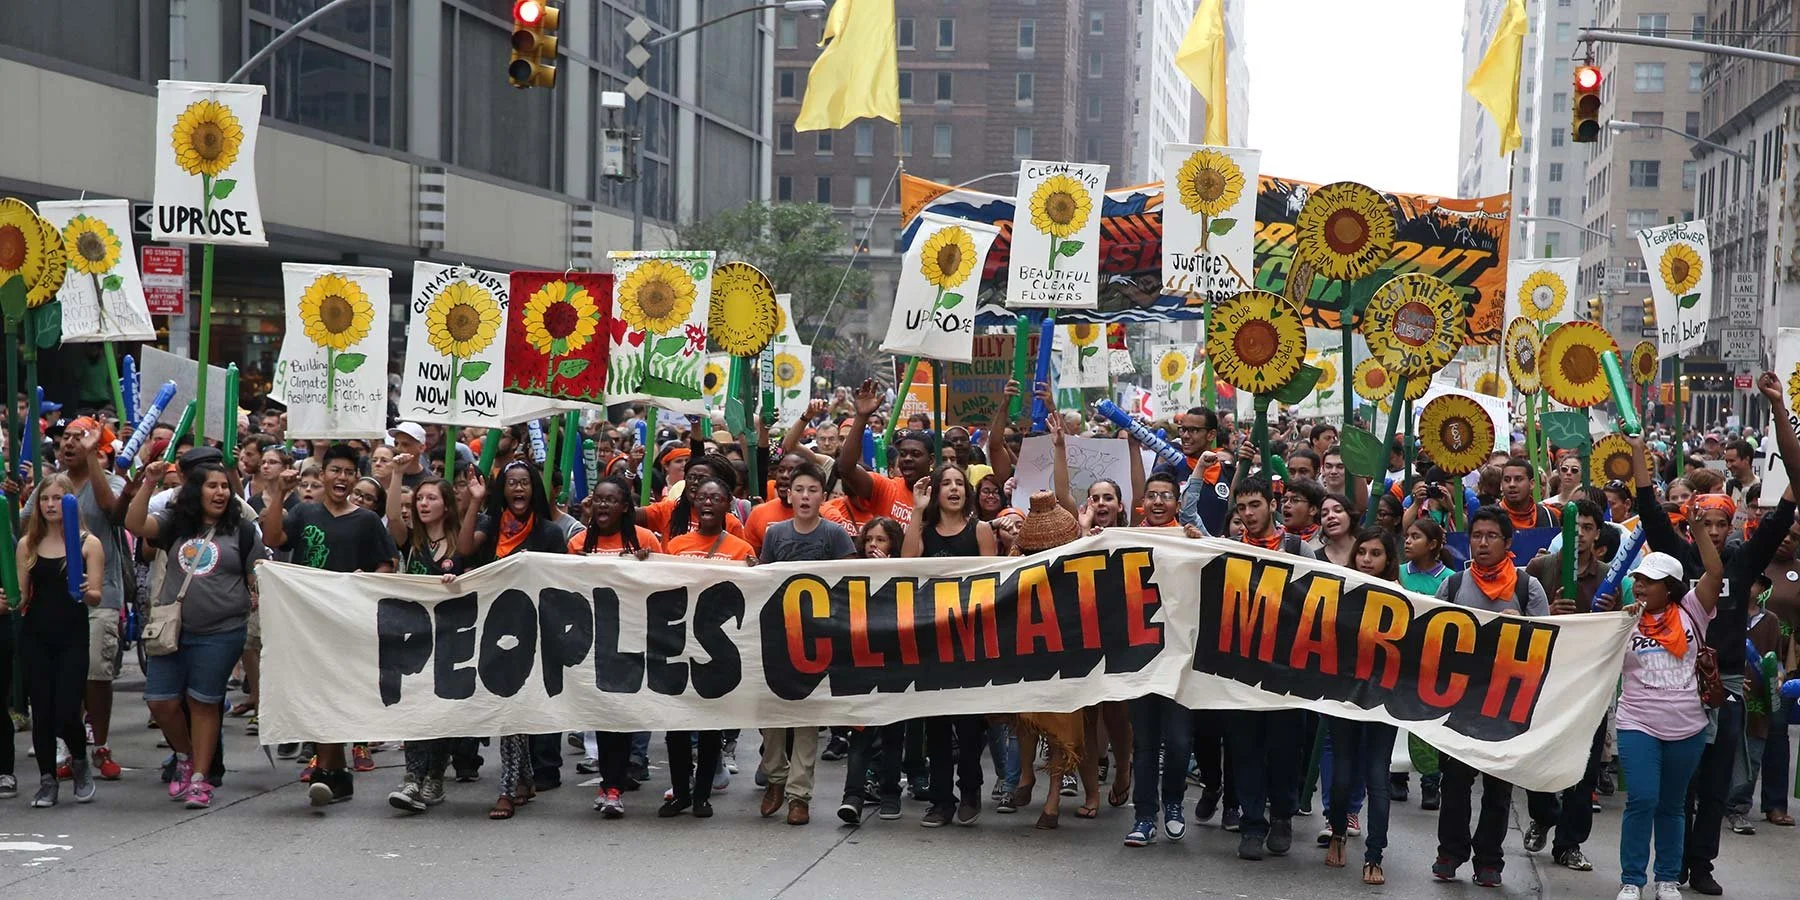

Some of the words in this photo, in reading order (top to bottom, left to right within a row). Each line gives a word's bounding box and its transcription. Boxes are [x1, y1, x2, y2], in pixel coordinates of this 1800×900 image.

[1028, 164, 1069, 180] CLEAN
[1075, 168, 1099, 190] AIR
[1313, 190, 1358, 217] CLIMATE
[159, 205, 252, 236] UPROSE
[1361, 198, 1386, 239] JUSTICE
[1305, 216, 1320, 255] WANT
[1675, 223, 1705, 246] POWER
[39, 249, 60, 289] FLOWER
[1315, 253, 1334, 271] WE
[1020, 265, 1091, 285] BEAUTIFUL
[1032, 279, 1076, 291] CLEAR
[1195, 274, 1202, 287] is
[1206, 273, 1217, 286] in
[1218, 276, 1236, 288] our
[1737, 274, 1752, 282] BUS
[414, 267, 459, 314] CLIMATE
[470, 269, 510, 310] JUSTICE
[1021, 290, 1083, 301] FLOWERS
[1380, 283, 1406, 311] GOT
[1409, 281, 1442, 302] THE
[1734, 285, 1753, 293] LANE
[752, 283, 770, 335] CLIMATE
[1374, 311, 1391, 332] WE
[1437, 299, 1455, 353] POWER
[1213, 338, 1240, 375] HELP
[1229, 304, 1251, 325] OUR
[1274, 339, 1295, 373] EARTH
[1662, 329, 1670, 344] in
[290, 359, 328, 377] Building
[418, 362, 451, 382] NOW
[761, 344, 775, 392] PROSE
[974, 360, 1005, 375] CLEAN
[290, 376, 327, 388] Climate
[369, 388, 383, 401] at
[416, 386, 449, 408] NOW
[464, 390, 497, 409] NOW
[343, 402, 368, 413] time
[953, 396, 988, 417] LAND
[528, 419, 548, 463] PROS
[1129, 420, 1184, 465] UPROSE
[378, 581, 746, 706] PEOPLES
[771, 549, 1163, 690] CLIMATE
[1212, 556, 1557, 732] MARCH
[1632, 629, 1693, 651] PEOS
